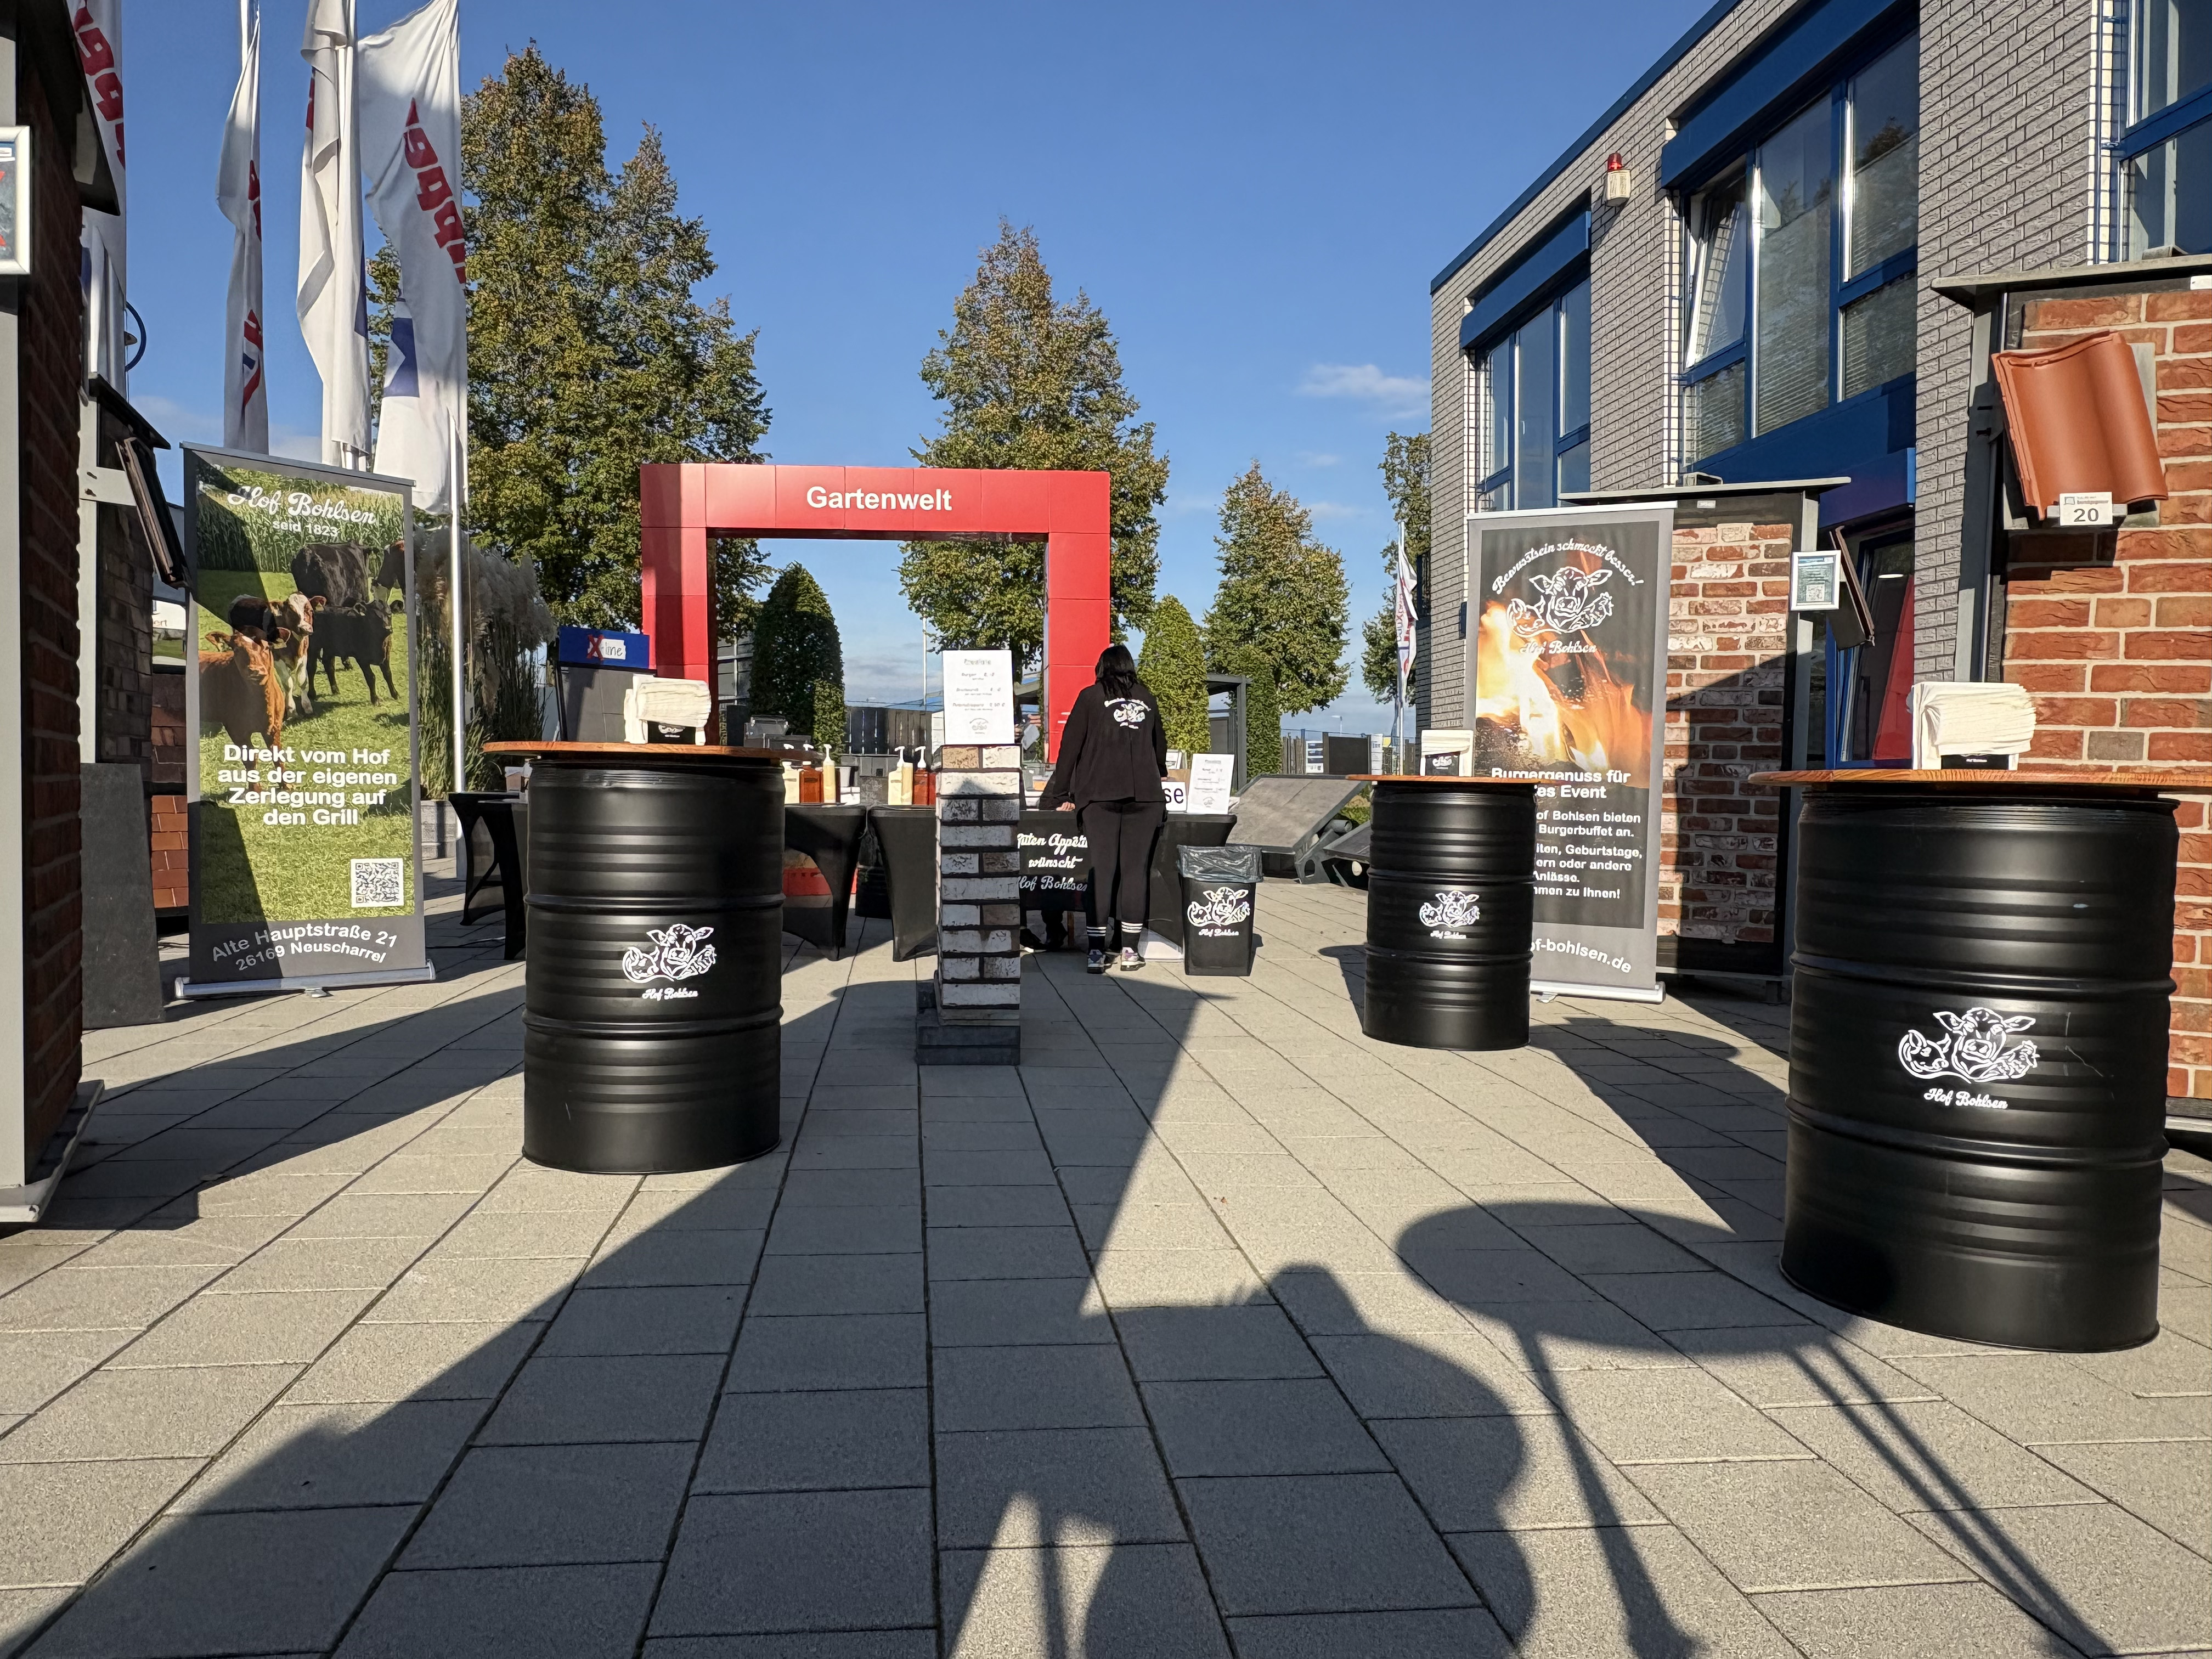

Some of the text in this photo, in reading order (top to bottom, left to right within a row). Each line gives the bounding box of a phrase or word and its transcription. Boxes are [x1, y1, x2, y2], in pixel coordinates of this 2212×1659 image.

[227, 486, 377, 524] Hof Bohlsen
[806, 486, 952, 511] Gartenwelt
[2073, 508, 2099, 522] 20
[273, 520, 340, 537] seid 1823
[1492, 538, 1644, 595] Bewusstsein schmeckt besser!
[1549, 641, 1597, 653] Bohlsen
[224, 745, 391, 765] Direkt vom Hof
[218, 766, 397, 787] aus der eigenen
[1607, 769, 1632, 783] für
[229, 788, 387, 808] Zerlegung auf
[1560, 785, 1607, 799] Event
[263, 809, 358, 825] den Grill
[1553, 810, 1599, 822] Bohlsen
[1604, 812, 1641, 824] bieten
[1539, 824, 1634, 837] Burgerbuffet an.
[1565, 844, 1643, 859] Geburtstage,
[1029, 856, 1083, 868] wünscht
[1559, 859, 1587, 869] oder
[1589, 860, 1632, 871] andere
[1566, 888, 1580, 896] zu
[1583, 887, 1620, 899] Ihnen!
[213, 923, 397, 962] Alte Hauptstraße 21
[235, 942, 387, 970] 26169 Neuscharrel
[1924, 1088, 2008, 1109] Hof Bohlsen
